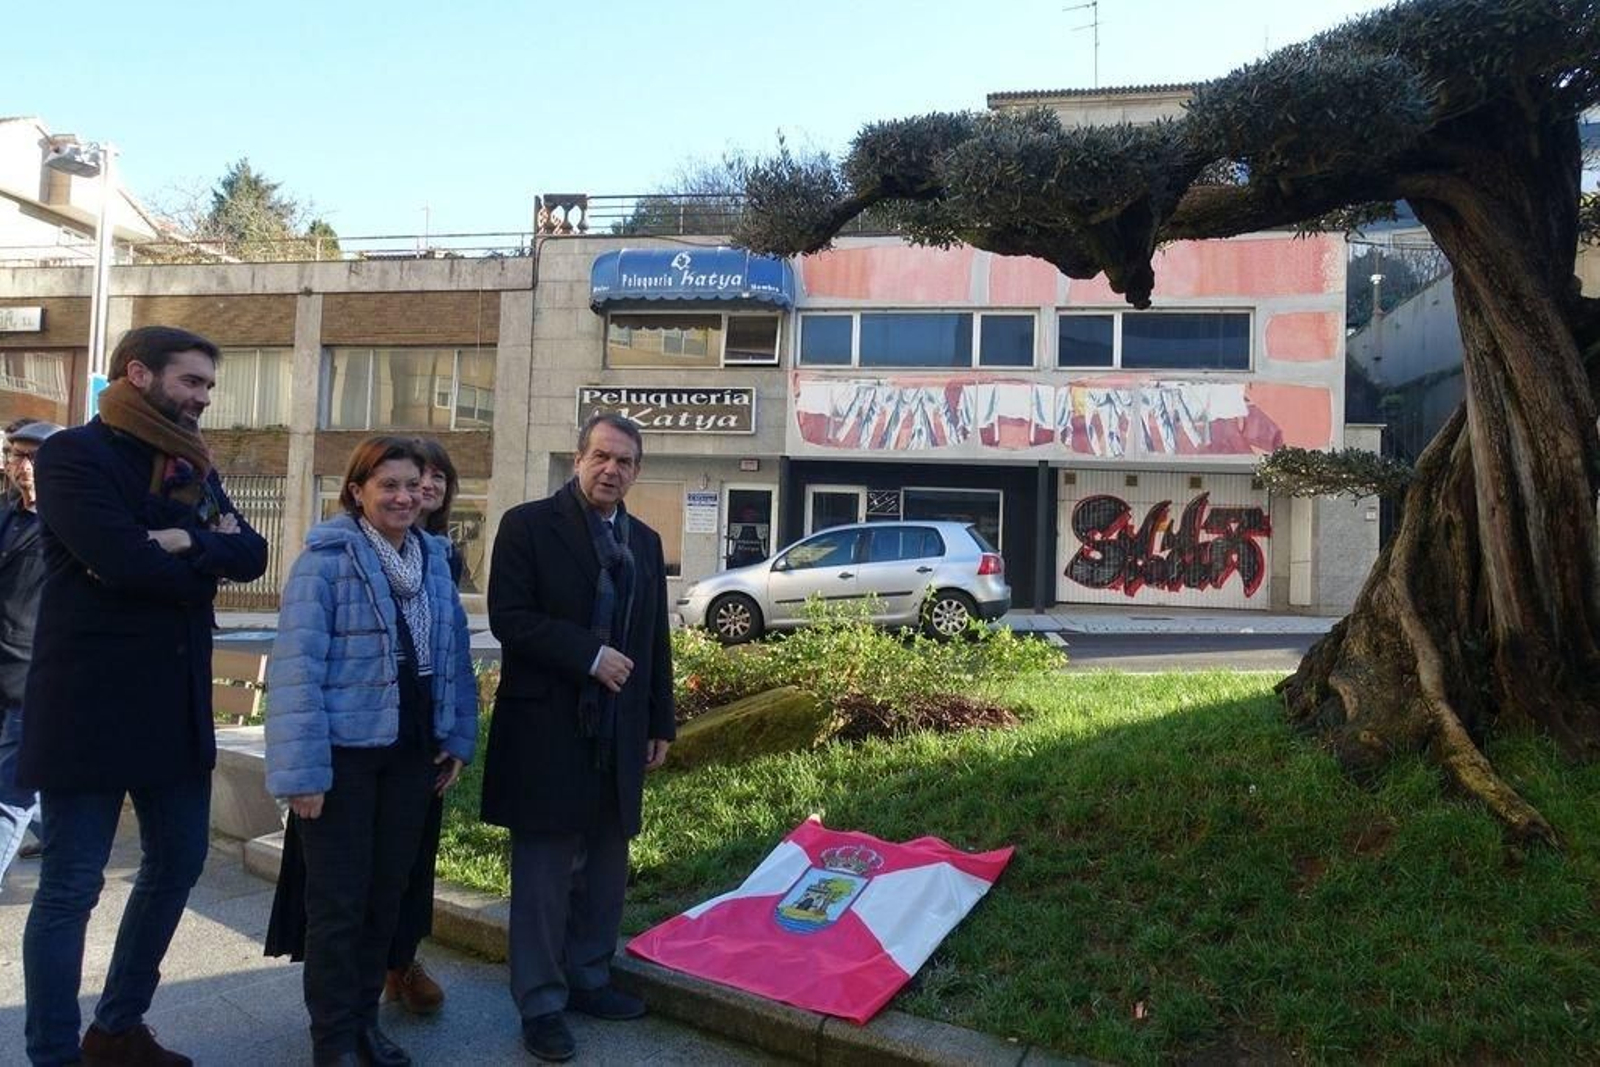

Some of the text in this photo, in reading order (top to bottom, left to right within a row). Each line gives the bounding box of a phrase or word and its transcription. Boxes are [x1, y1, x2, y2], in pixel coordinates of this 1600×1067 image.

[681, 270, 743, 290] Katya
[582, 390, 751, 408] Peluquería
[618, 407, 739, 431] Katya
